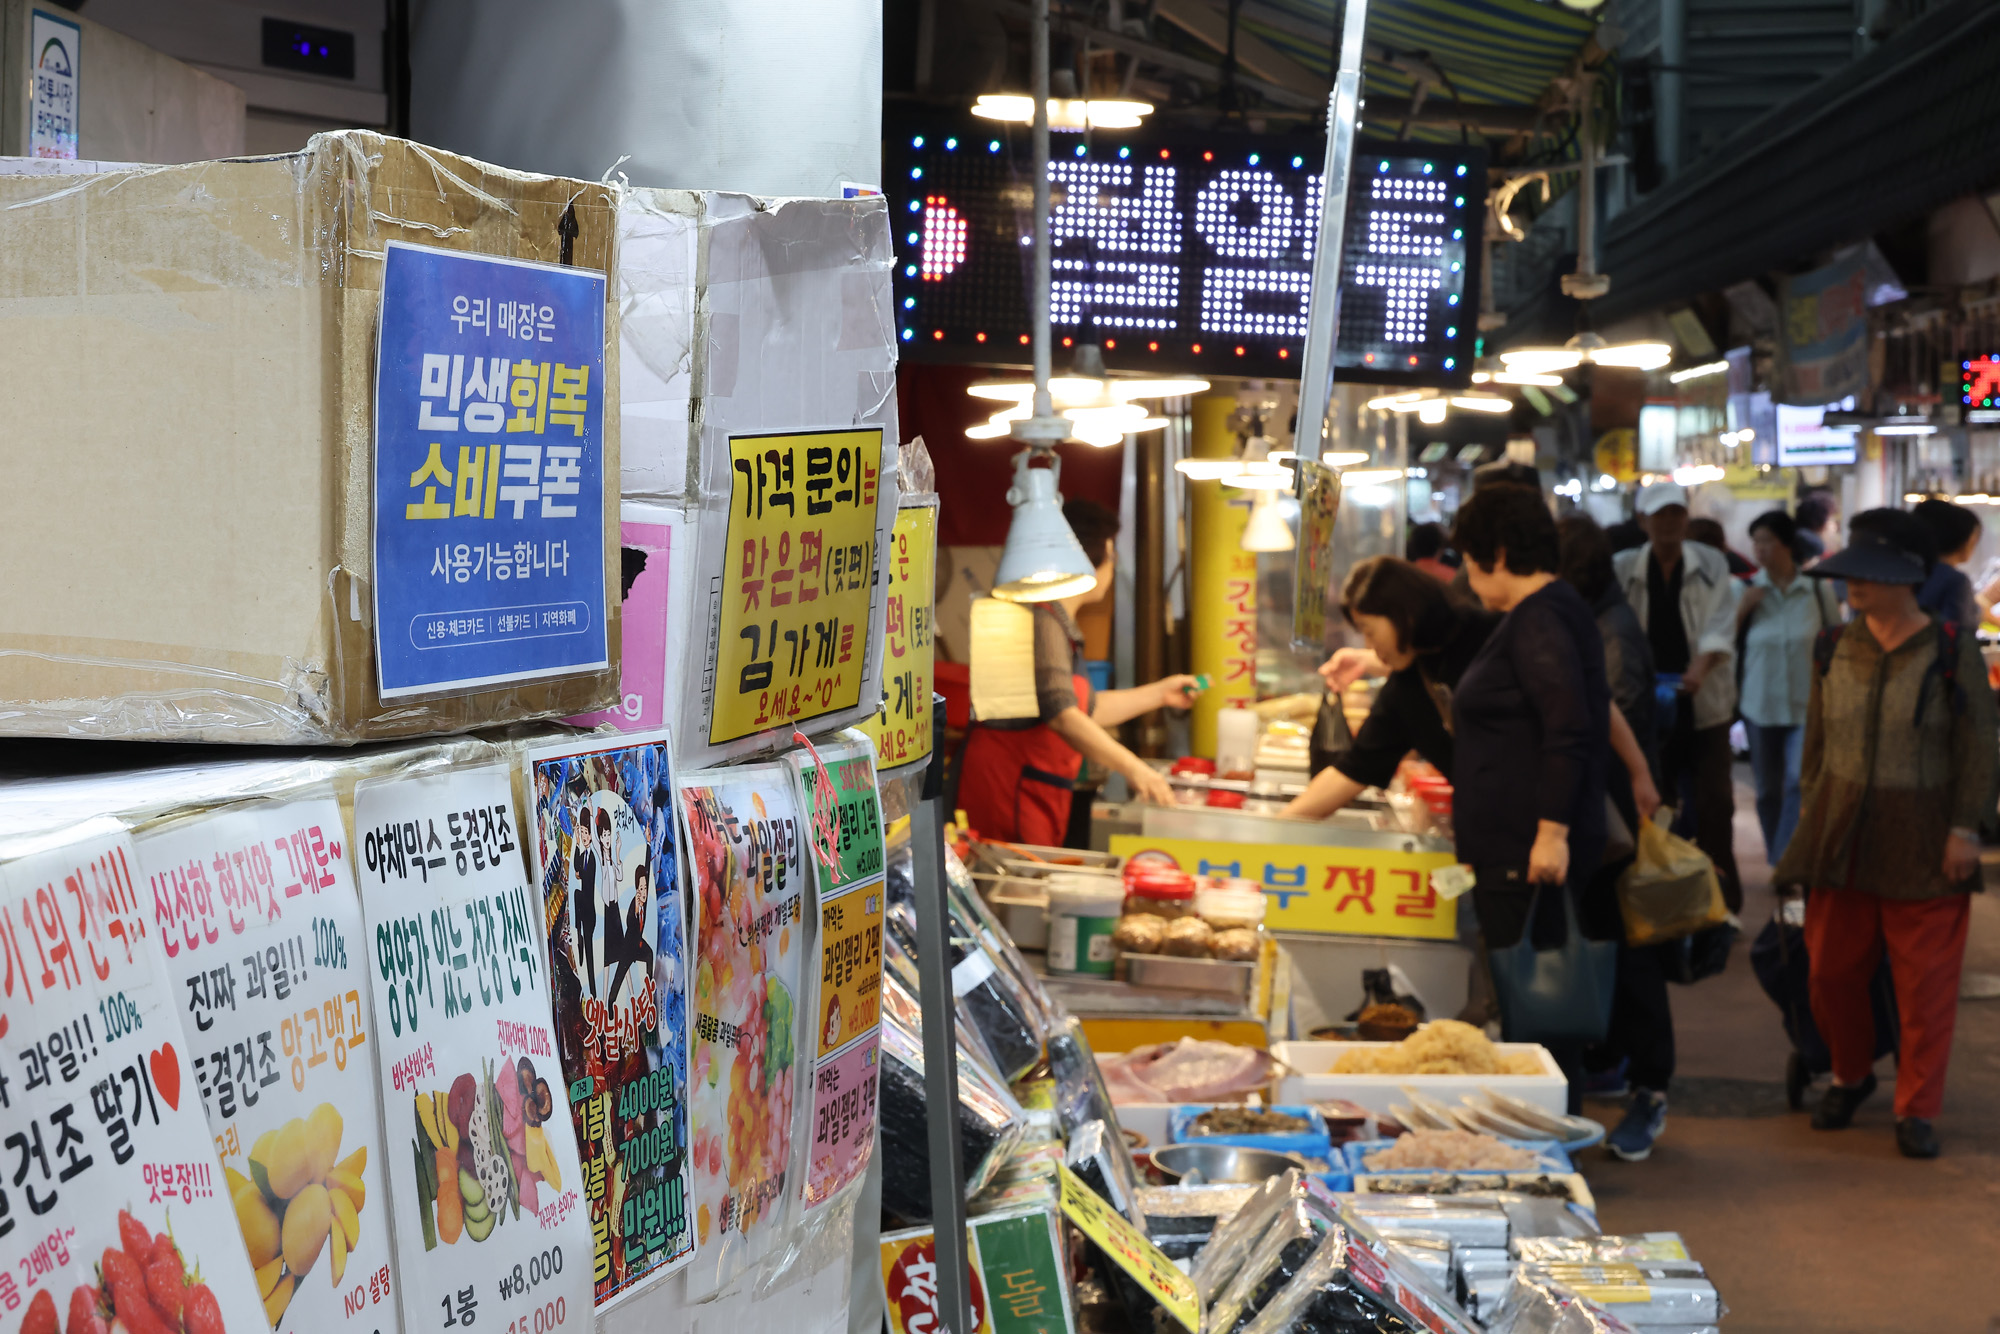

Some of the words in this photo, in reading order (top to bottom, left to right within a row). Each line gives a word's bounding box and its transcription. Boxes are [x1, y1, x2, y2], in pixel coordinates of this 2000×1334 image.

[450, 295, 491, 336] 우리
[498, 301, 556, 343] 매장은
[418, 353, 590, 437] 민생회복
[405, 442, 582, 521] 소비쿠폰
[734, 447, 795, 520] 가격
[430, 539, 570, 584] 사용가능합니다
[496, 613, 531, 634] 선불카드
[542, 607, 577, 627] 지역화폐
[364, 819, 447, 886] 야채믹스
[447, 804, 516, 877] 동결건조
[741, 815, 800, 894] 과일젤리
[22, 882, 82, 991] 1위
[64, 845, 146, 981] 간식!!
[150, 859, 219, 959] 신선한
[212, 840, 282, 935] 현지맛
[823, 903, 844, 936] 까먹는
[1322, 865, 1437, 919] 젓갈
[186, 959, 237, 1032] 진짜
[246, 934, 308, 1001] 과일!!
[311, 916, 348, 970] 100%
[375, 917, 434, 1038] 영양가
[431, 905, 473, 1019] 있는
[465, 895, 504, 1007] 건강
[823, 931, 863, 988] 과일젤리
[19, 1012, 98, 1091] 과일!!
[99, 991, 143, 1043] 100%
[528, 1025, 551, 1058] 100%
[584, 976, 656, 1060] 옛날사탕
[696, 1012, 719, 1044] 새콤달콤
[391, 1040, 436, 1093] 바삭바삭
[575, 1082, 588, 1097] 가격
[818, 1065, 841, 1094] 까먹는
[90, 1053, 160, 1166] 딸기
[579, 1093, 604, 1141] 1봉
[618, 1063, 675, 1122] 4000원
[817, 1084, 860, 1146] 과일젤리
[142, 1162, 213, 1206] 맛보장!!!
[581, 1153, 606, 1202] 2봉
[619, 1118, 675, 1183] 7000원
[538, 1202, 559, 1231] 자꾸만
[591, 1211, 611, 1284] 봉
[623, 1175, 685, 1264] 만원!!!
[344, 1285, 365, 1319] NO
[369, 1264, 390, 1304] 설탕
[441, 1284, 478, 1328] 1봉
[499, 1245, 563, 1301] ₩8,000
